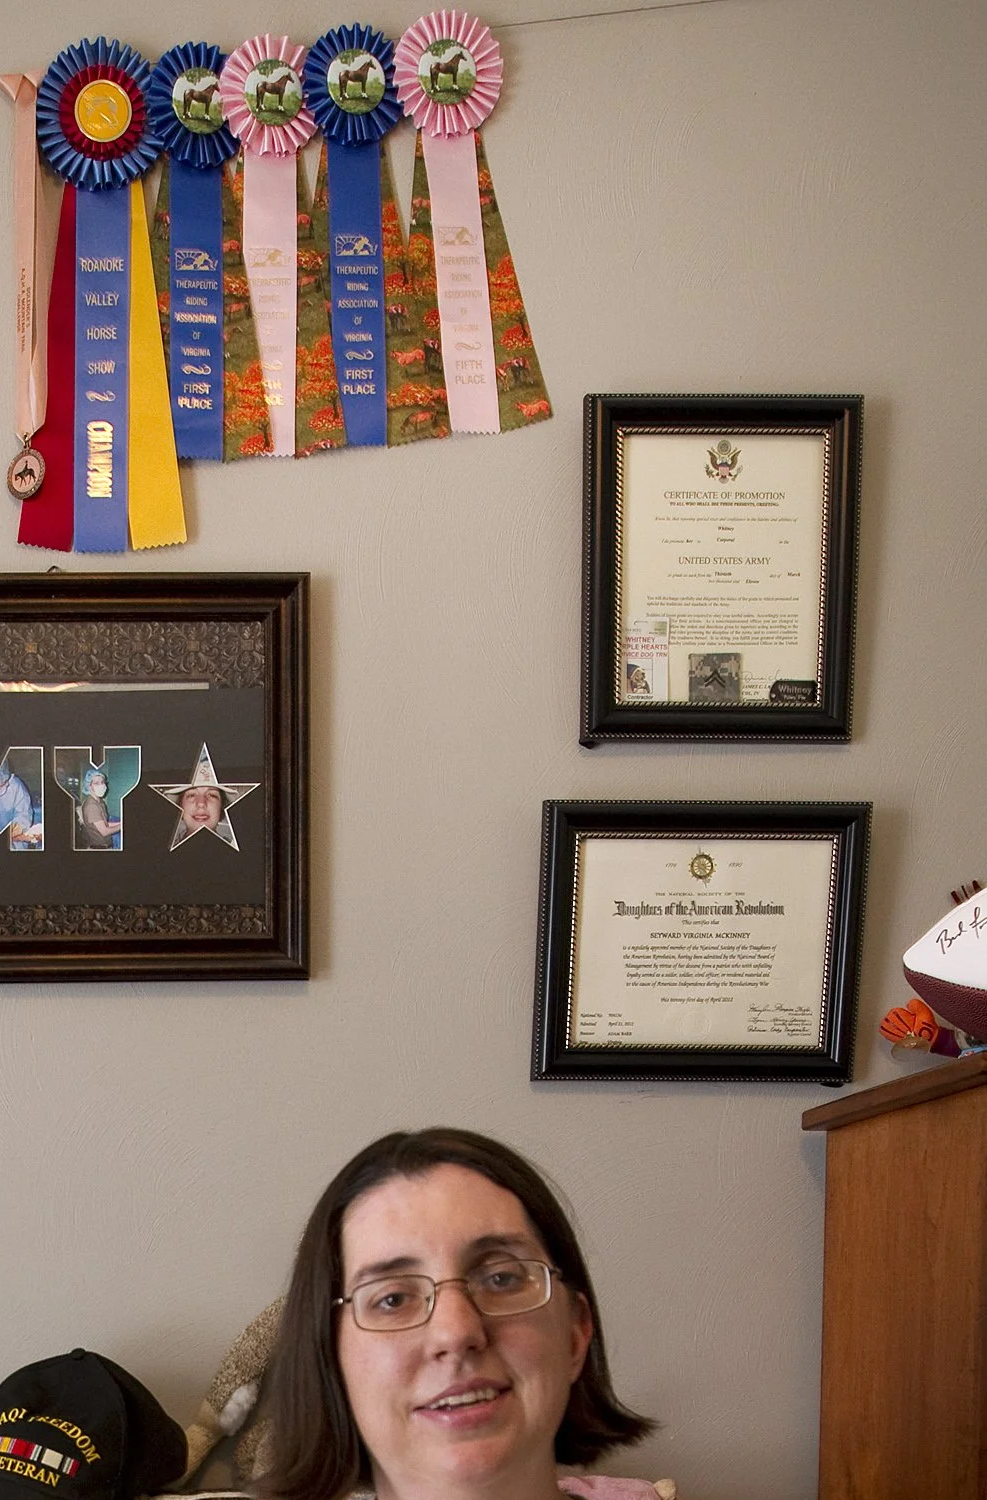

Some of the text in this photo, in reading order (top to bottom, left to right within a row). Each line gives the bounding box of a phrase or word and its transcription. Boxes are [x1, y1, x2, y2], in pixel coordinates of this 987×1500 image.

[80, 258, 125, 272] ROANOKE
[440, 255, 481, 266] THERAPEUTIC
[336, 265, 379, 276] THERAPEUTIC
[176, 280, 219, 291] THERAPEUTIC
[346, 282, 369, 292] RIDING
[85, 293, 120, 307] VALLEY
[185, 296, 208, 307] RIDING
[337, 299, 379, 309] ASSOCIATION
[175, 313, 217, 325] ASSOCIATION
[354, 316, 363, 326] OF
[87, 327, 117, 341] HORSE
[192, 331, 202, 341] OF
[345, 332, 373, 343] VIRGINIA
[182, 347, 211, 357] VIRGINIA
[88, 361, 116, 376] SHOW
[455, 359, 483, 371] FIFTH
[346, 368, 375, 380] FIRST
[455, 374, 487, 385] PLACE
[183, 384, 212, 394] FIRST
[342, 384, 376, 395] PLACE
[178, 396, 213, 410] PLACE
[87, 420, 114, 498] CHAMPION
[663, 491, 786, 500] CERTIFICATE OF PROMOTION
[678, 556, 772, 566] UNITED STATES ARMY
[778, 684, 812, 696] Whitney
[612, 899, 785, 920] Daughters of the American Revolution
